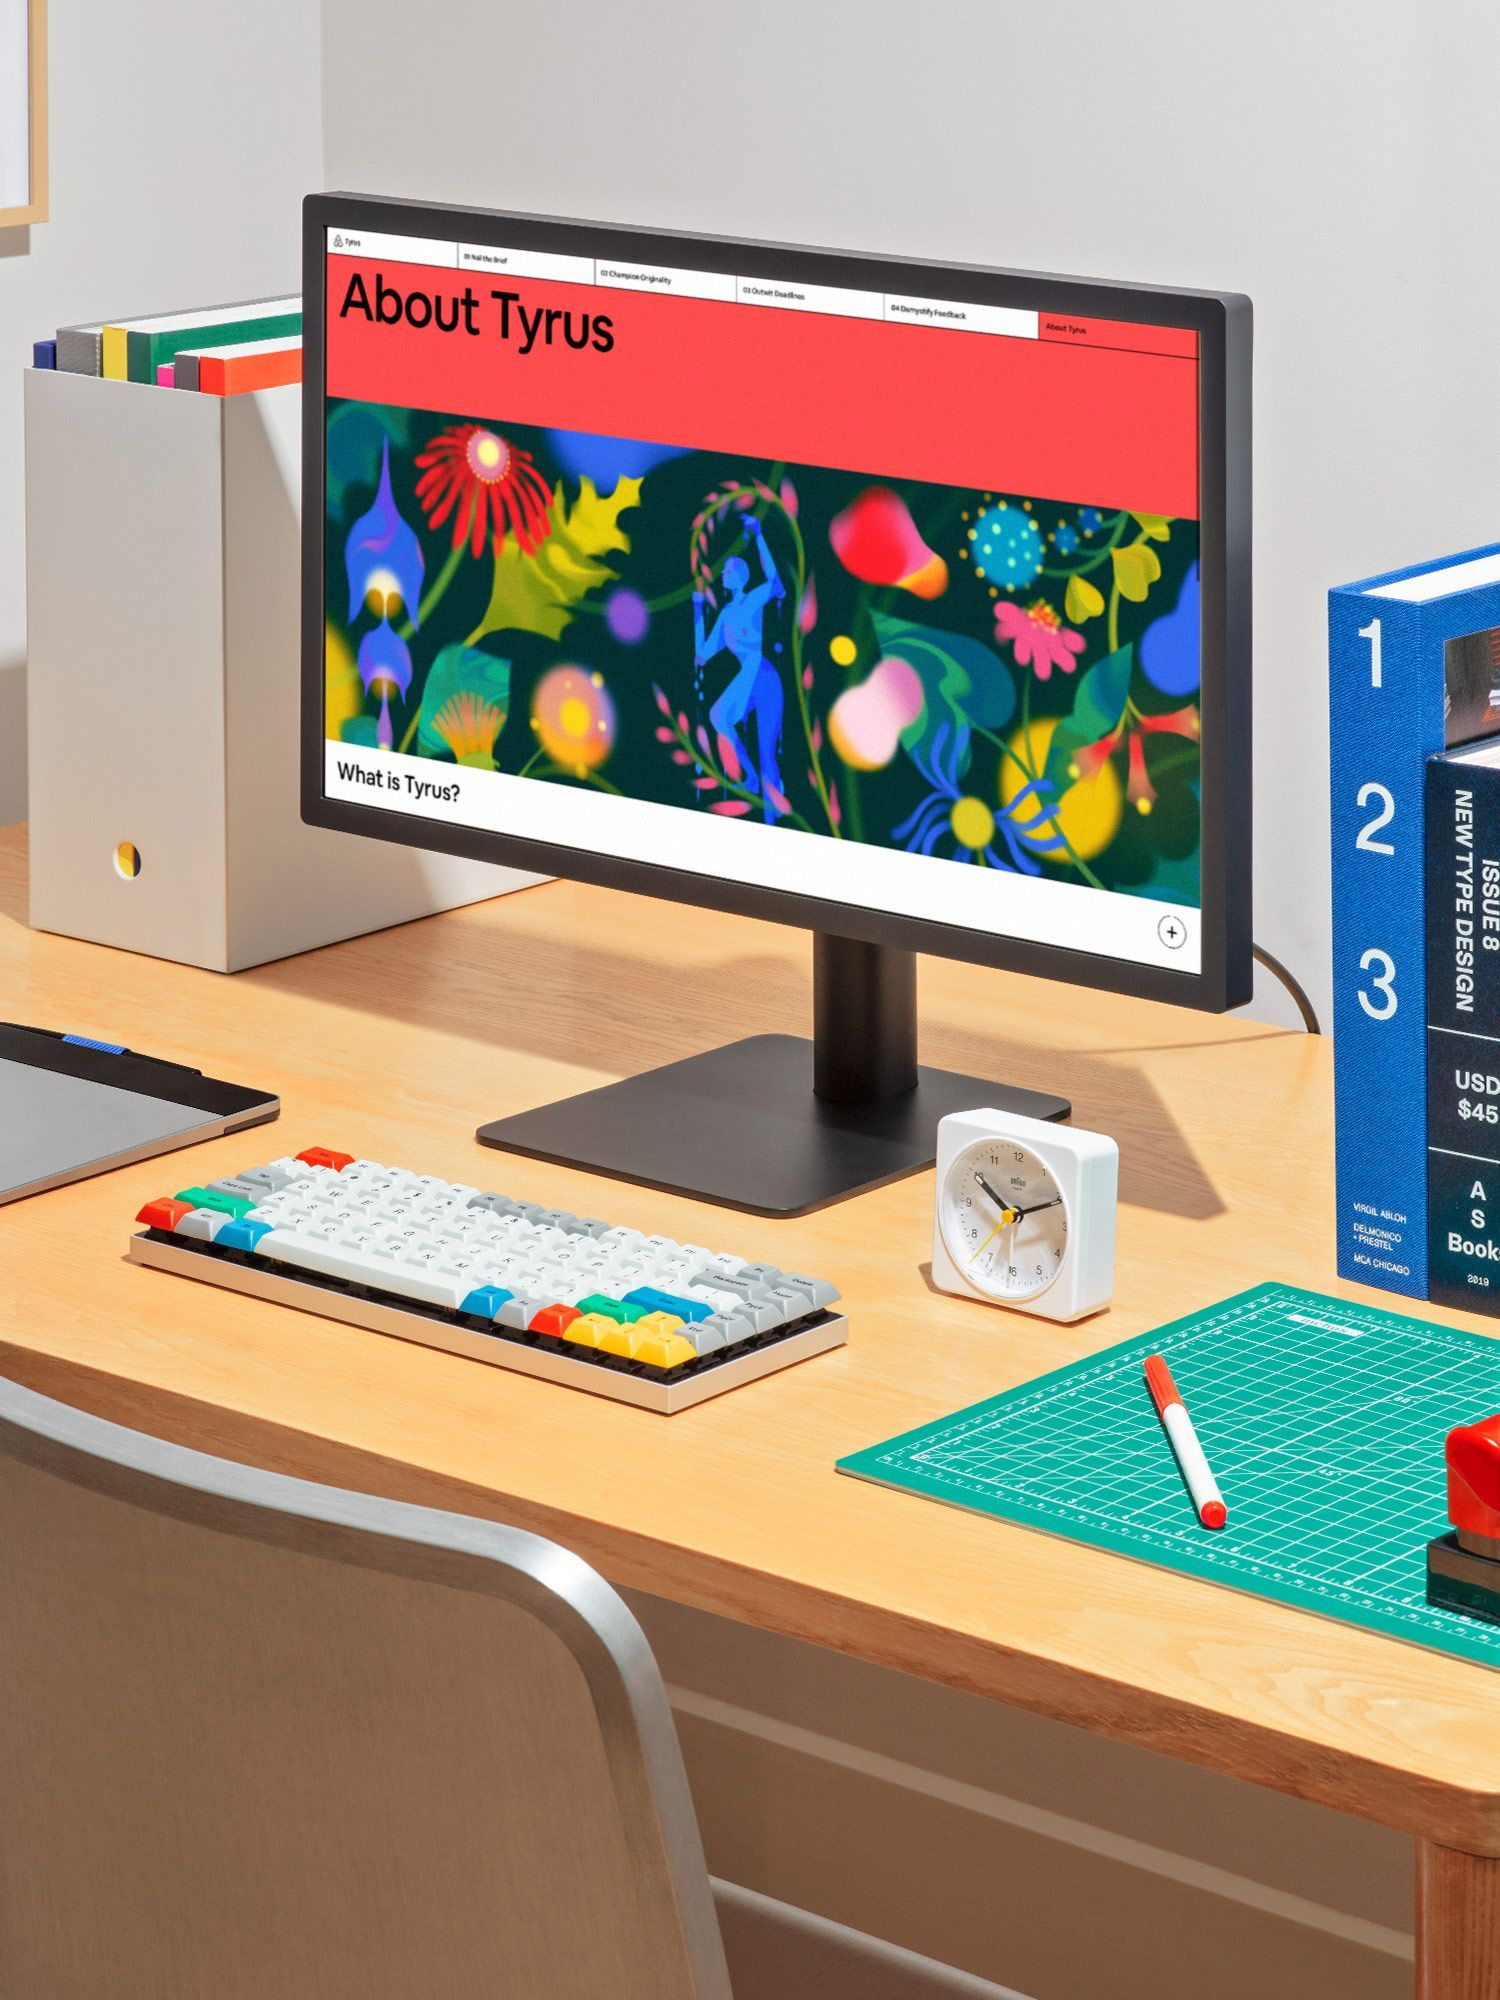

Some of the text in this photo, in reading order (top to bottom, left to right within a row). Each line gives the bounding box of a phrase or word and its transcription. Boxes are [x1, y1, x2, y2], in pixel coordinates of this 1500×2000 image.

[345, 238, 361, 247] Tyrus
[609, 270, 639, 281] Champion
[640, 273, 672, 286] Originality
[752, 287, 773, 296] Outwit
[774, 290, 805, 300] Deadlines
[339, 273, 615, 355] About Tyrus
[900, 305, 933, 318] Demystify
[934, 309, 966, 320] Feedback
[1046, 323, 1087, 334] About Tyrus
[1358, 618, 1381, 688] 1
[337, 761, 461, 802] What is Tyrus?
[1355, 782, 1395, 856] 2
[1455, 789, 1474, 1013] NEW TYPE DESIGN
[1482, 859, 1500, 951] ISSUE 8
[1357, 948, 1398, 1020] 3
[1455, 1069, 1500, 1095] USD
[1457, 1098, 1499, 1124] $45
[990, 1155, 998, 1166] 11
[1013, 1151, 1024, 1163] 12
[1470, 1180, 1487, 1201] A
[966, 1198, 972, 1207] 9
[1353, 1202, 1407, 1224] VIRGIL ABLOH
[1471, 1209, 1486, 1229] S
[972, 1229, 978, 1238] 8
[1353, 1222, 1402, 1243] DELMONICO
[1358, 1234, 1393, 1251] PRESTEL
[1055, 1249, 1060, 1258] 4
[1448, 1232, 1500, 1261] Book
[1036, 1265, 1042, 1275] 5
[1353, 1253, 1410, 1275] MCA CHICAGO
[1467, 1274, 1490, 1287] 2019
